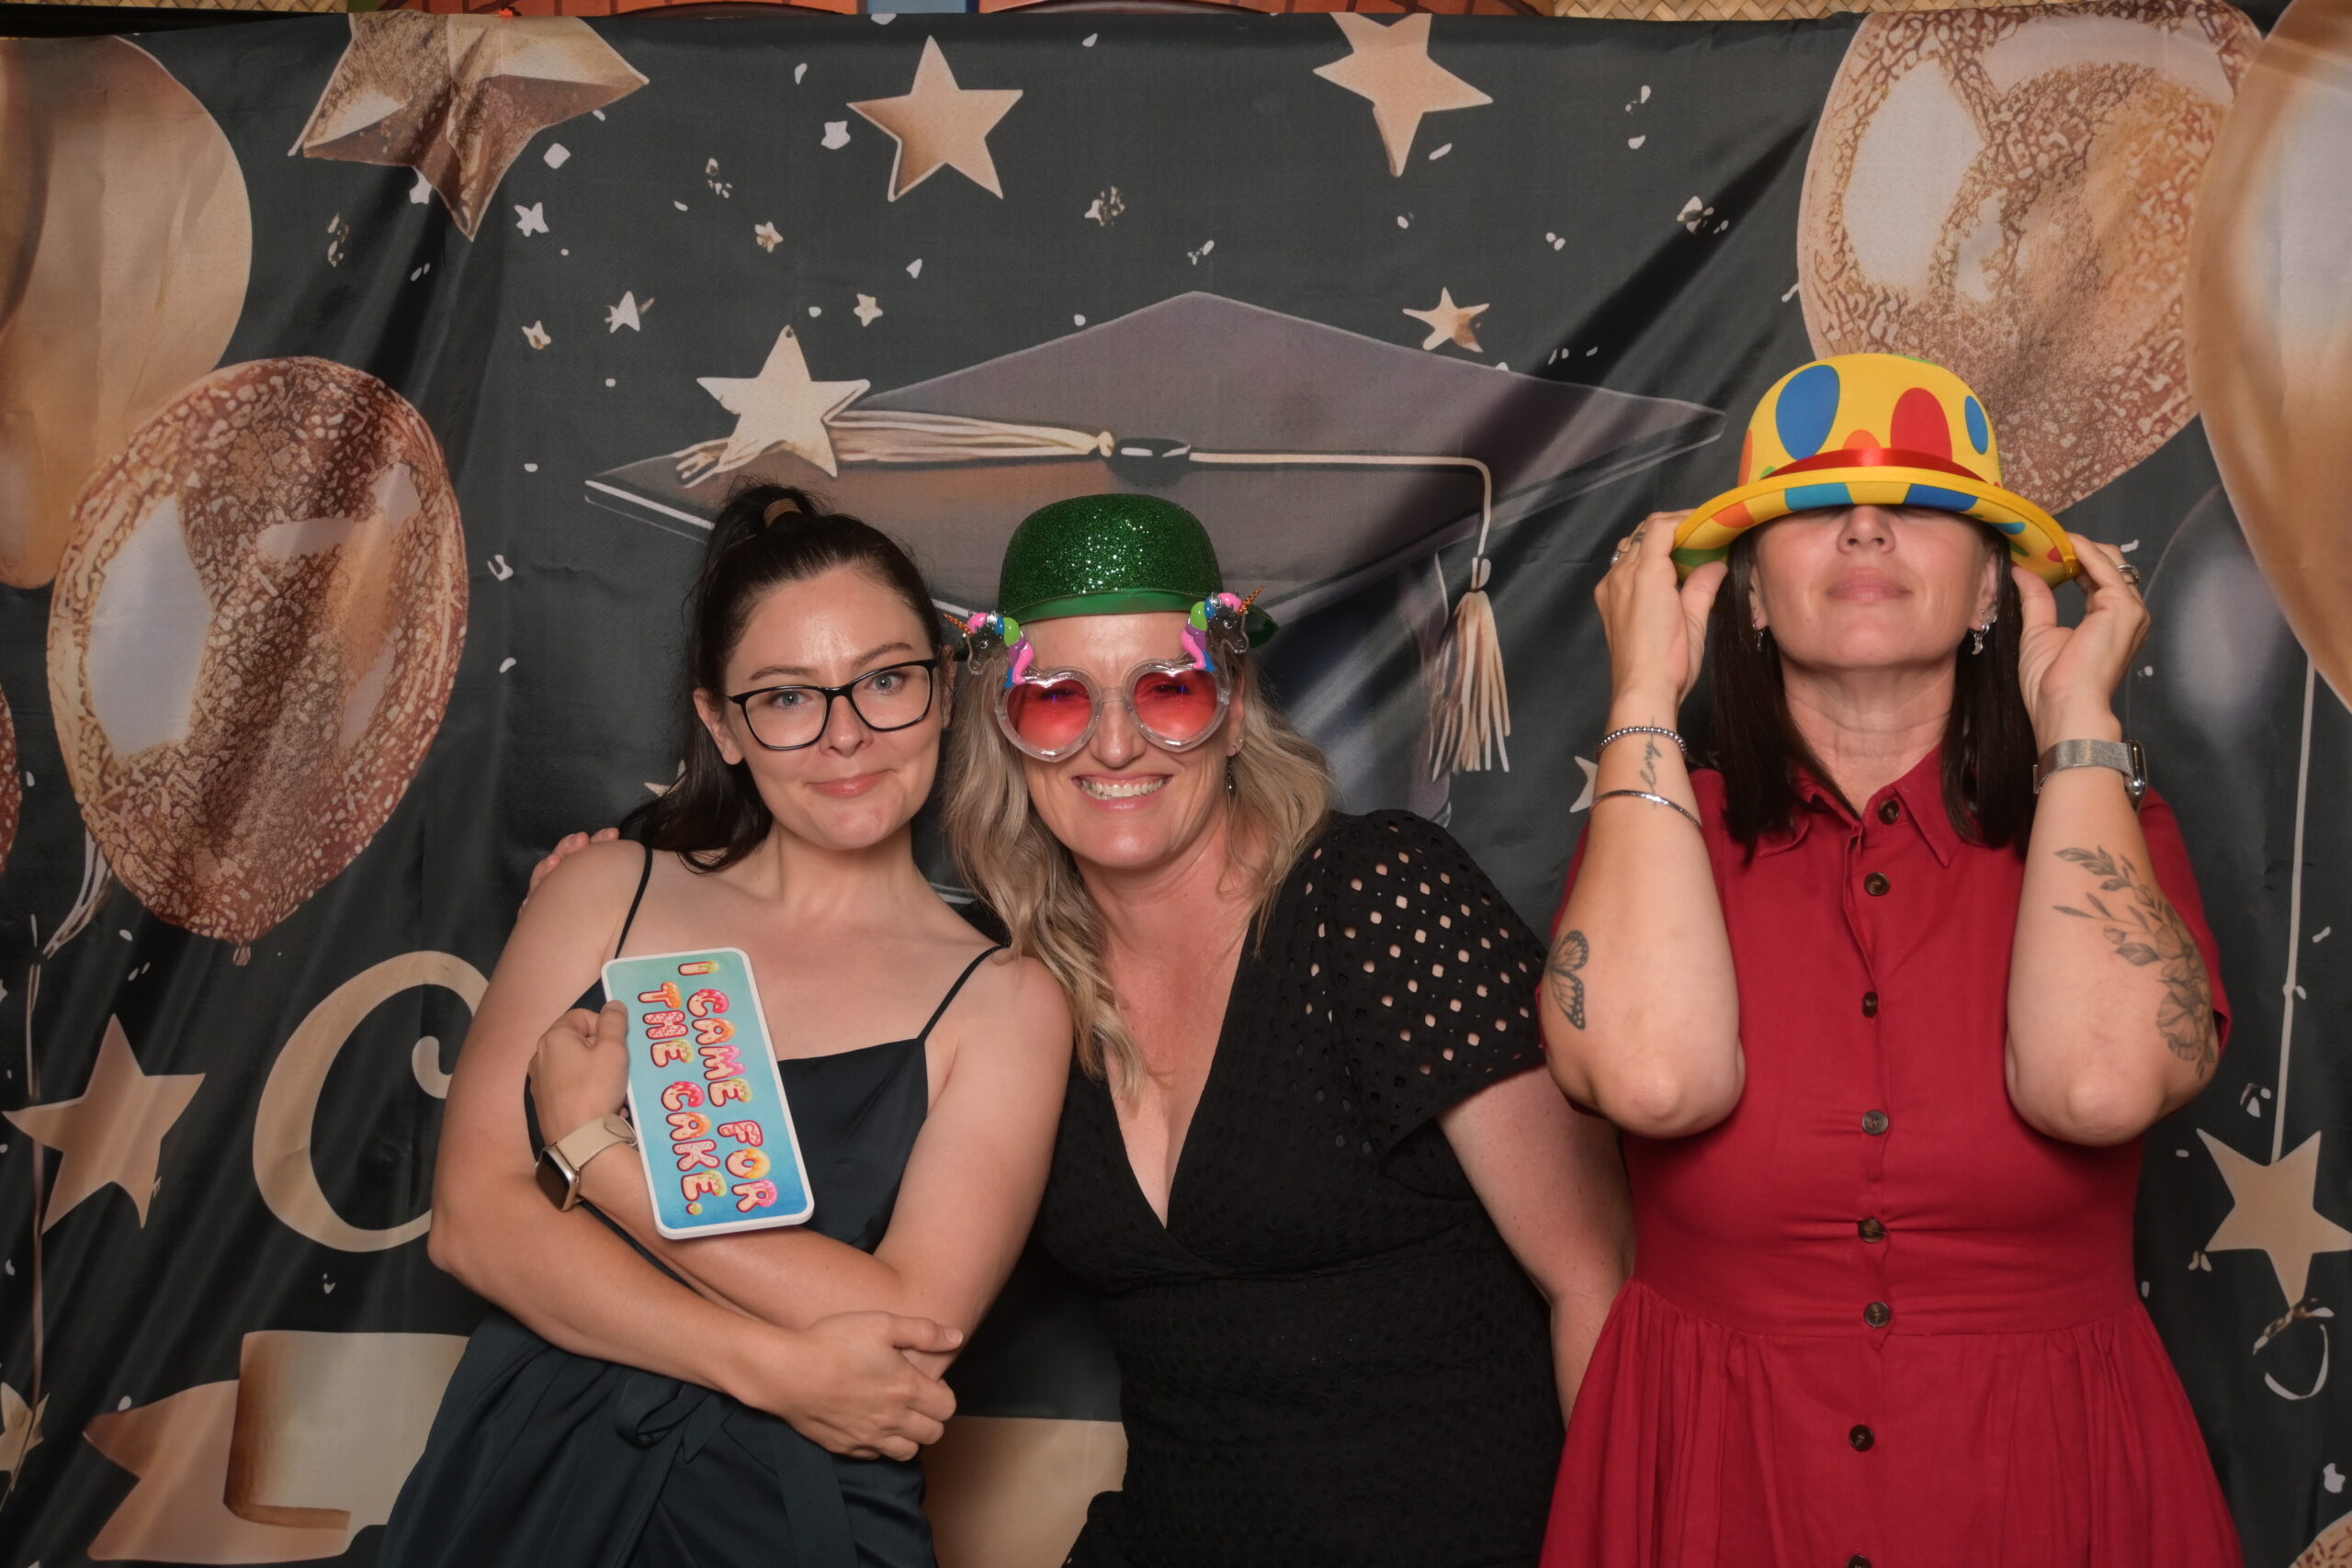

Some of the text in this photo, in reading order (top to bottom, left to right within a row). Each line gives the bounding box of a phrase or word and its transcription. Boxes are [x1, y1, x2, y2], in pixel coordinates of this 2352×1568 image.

[638, 981, 728, 1215] THE CAKE.
[678, 961, 779, 1213] I CAME FOR
